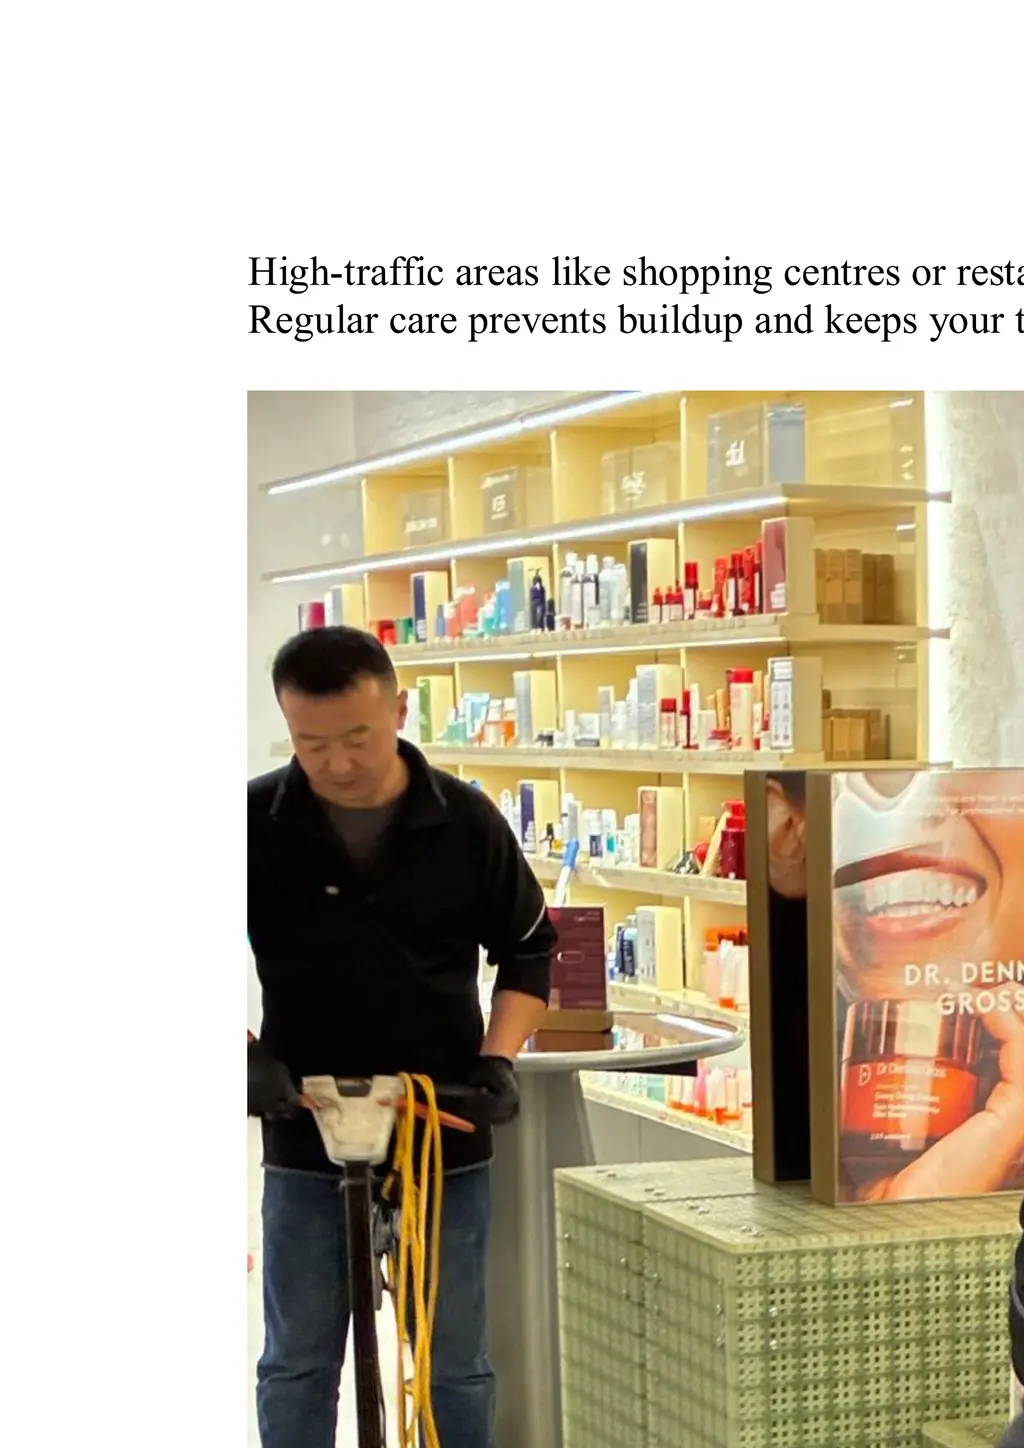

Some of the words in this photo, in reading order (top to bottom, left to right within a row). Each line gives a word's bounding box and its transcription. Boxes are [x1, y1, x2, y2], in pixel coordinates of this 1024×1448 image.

[249, 256, 443, 294] High-traffic
[456, 266, 538, 286] areas
[552, 256, 610, 286] like
[624, 256, 772, 294] shopping
[785, 261, 900, 286] centres
[913, 266, 946, 286] or
[249, 304, 378, 342] Regular
[390, 314, 456, 334] care
[468, 309, 606, 342] prevents
[618, 304, 742, 342] buildup
[756, 304, 813, 334] and
[825, 304, 917, 342] keeps
[929, 314, 1004, 342] your
[904, 963, 951, 986] DR.
